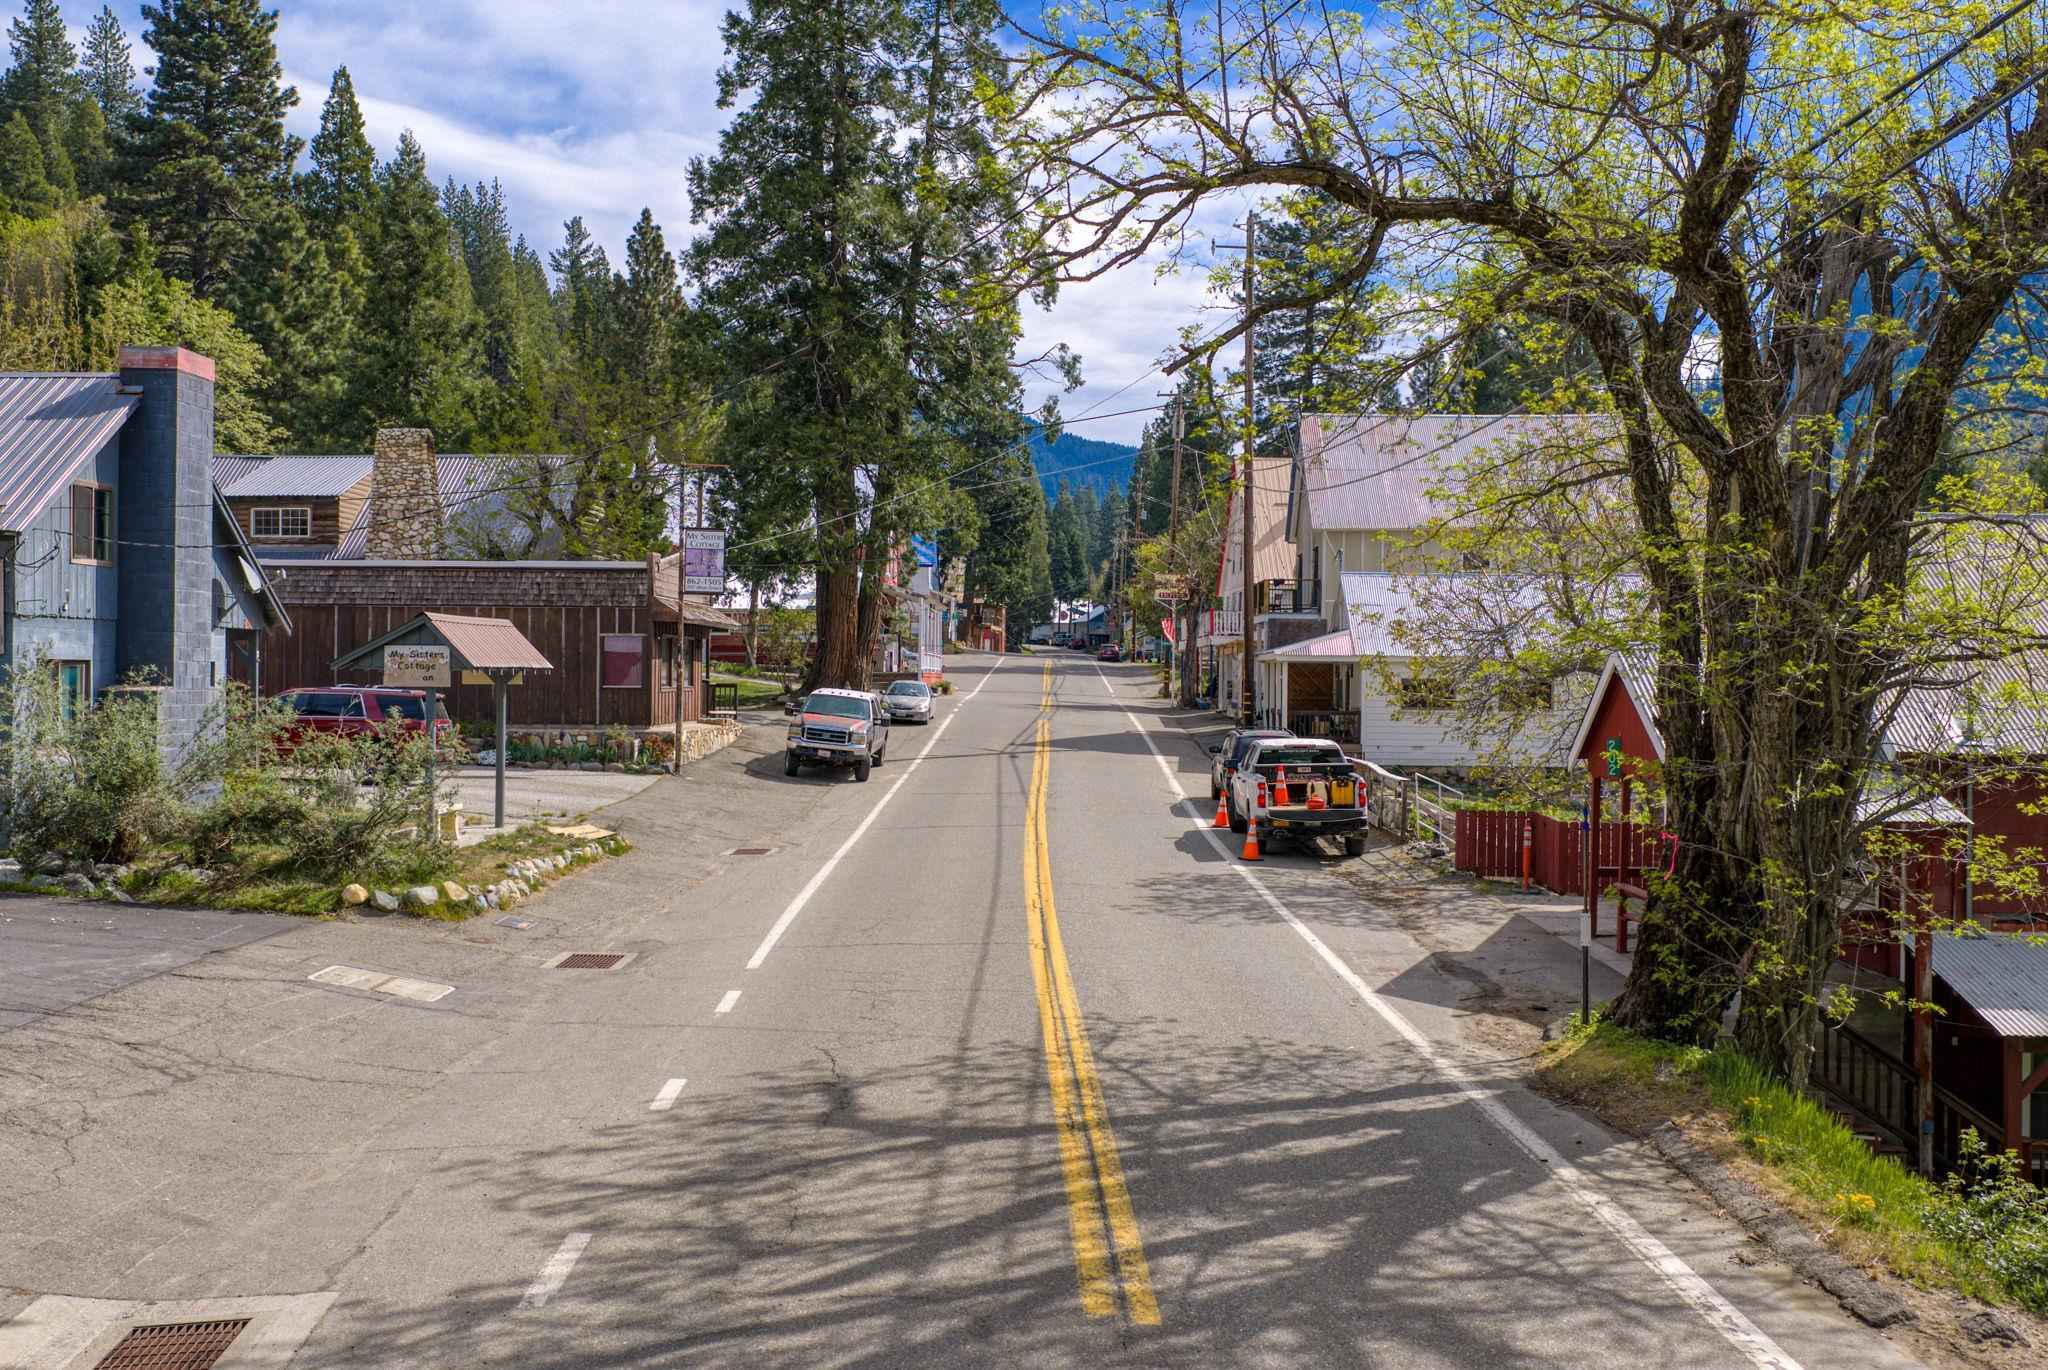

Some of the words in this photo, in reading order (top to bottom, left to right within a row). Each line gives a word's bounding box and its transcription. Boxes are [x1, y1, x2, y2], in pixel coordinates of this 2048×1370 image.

[388, 650, 405, 660] My
[397, 661, 436, 672] Cottage
[1608, 740, 1617, 776] 202
